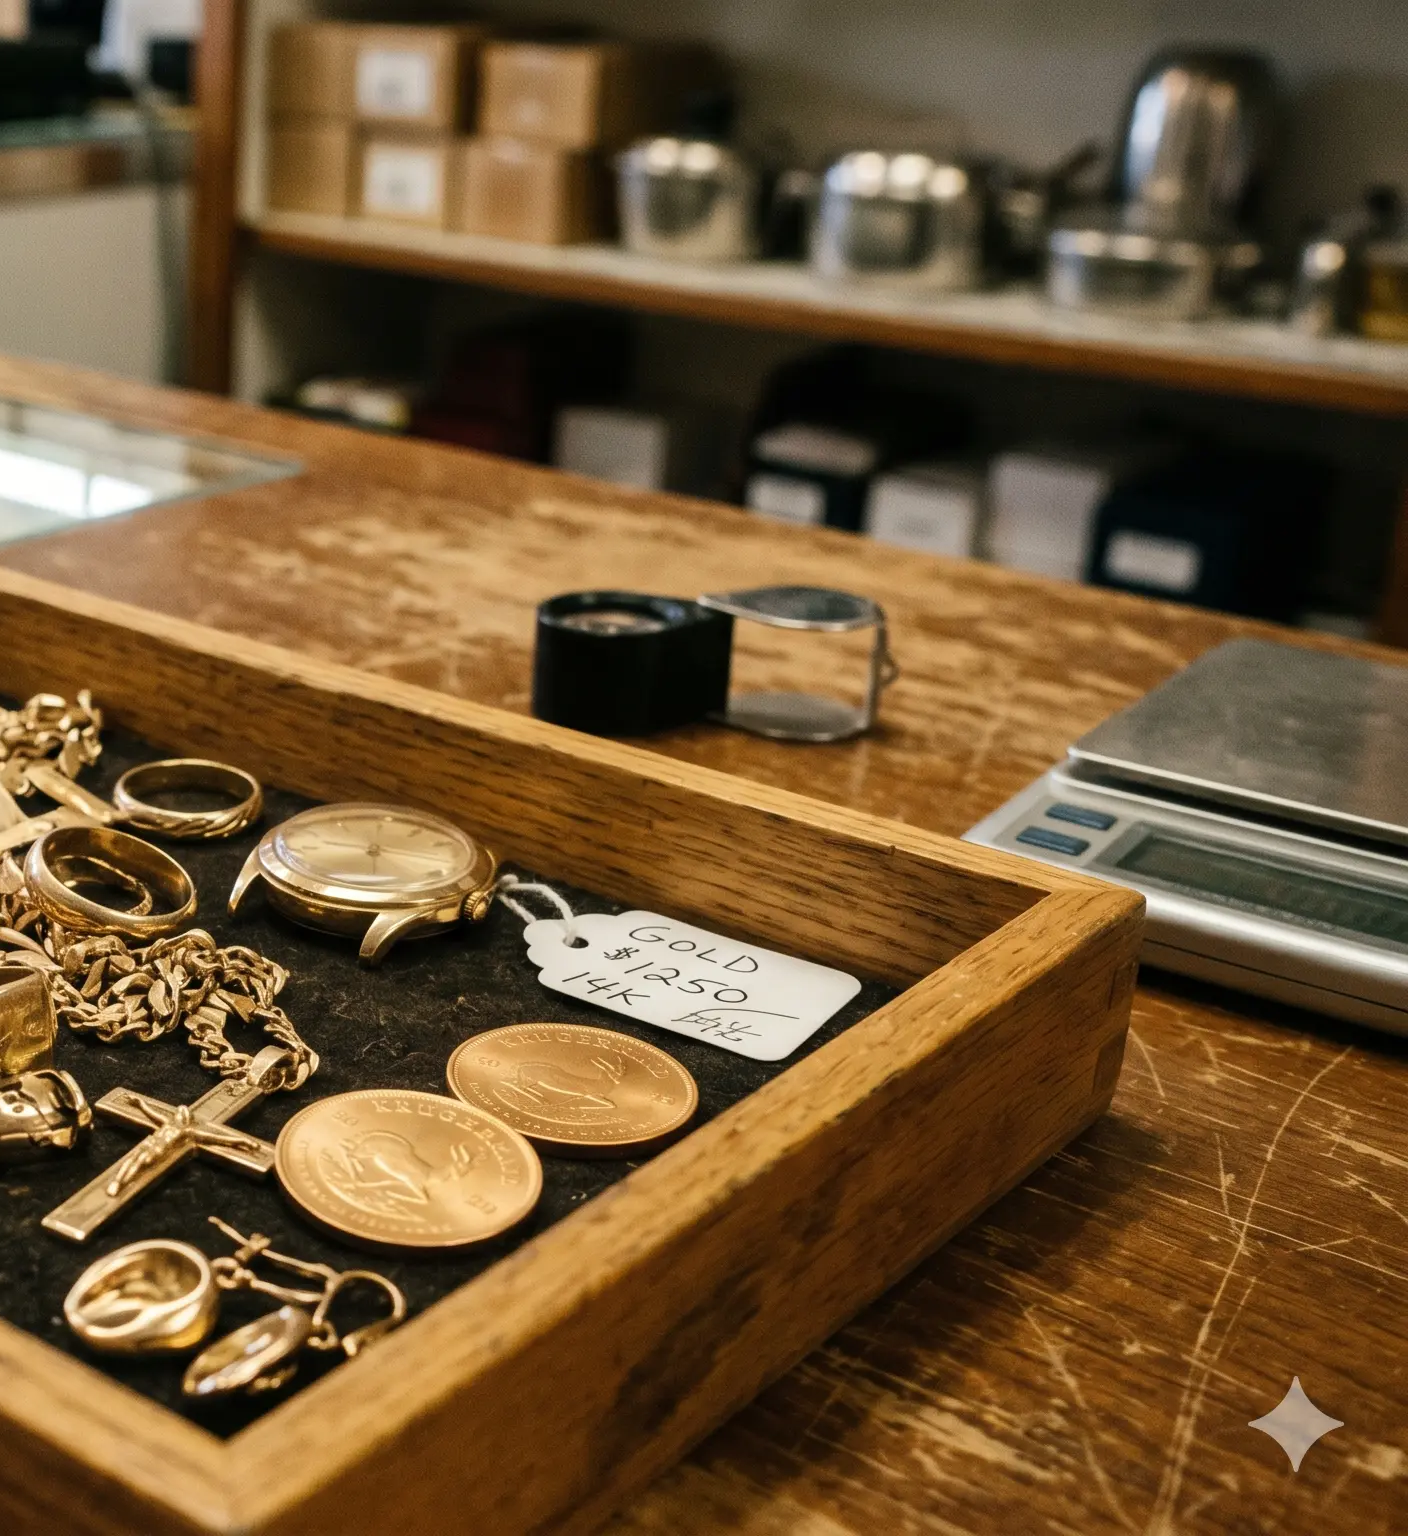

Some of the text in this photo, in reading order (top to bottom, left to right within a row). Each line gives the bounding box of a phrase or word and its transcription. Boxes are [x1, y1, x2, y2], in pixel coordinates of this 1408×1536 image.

[628, 926, 759, 974] GOLD
[561, 971, 651, 1006] 14K
[603, 947, 748, 1003] $1250
